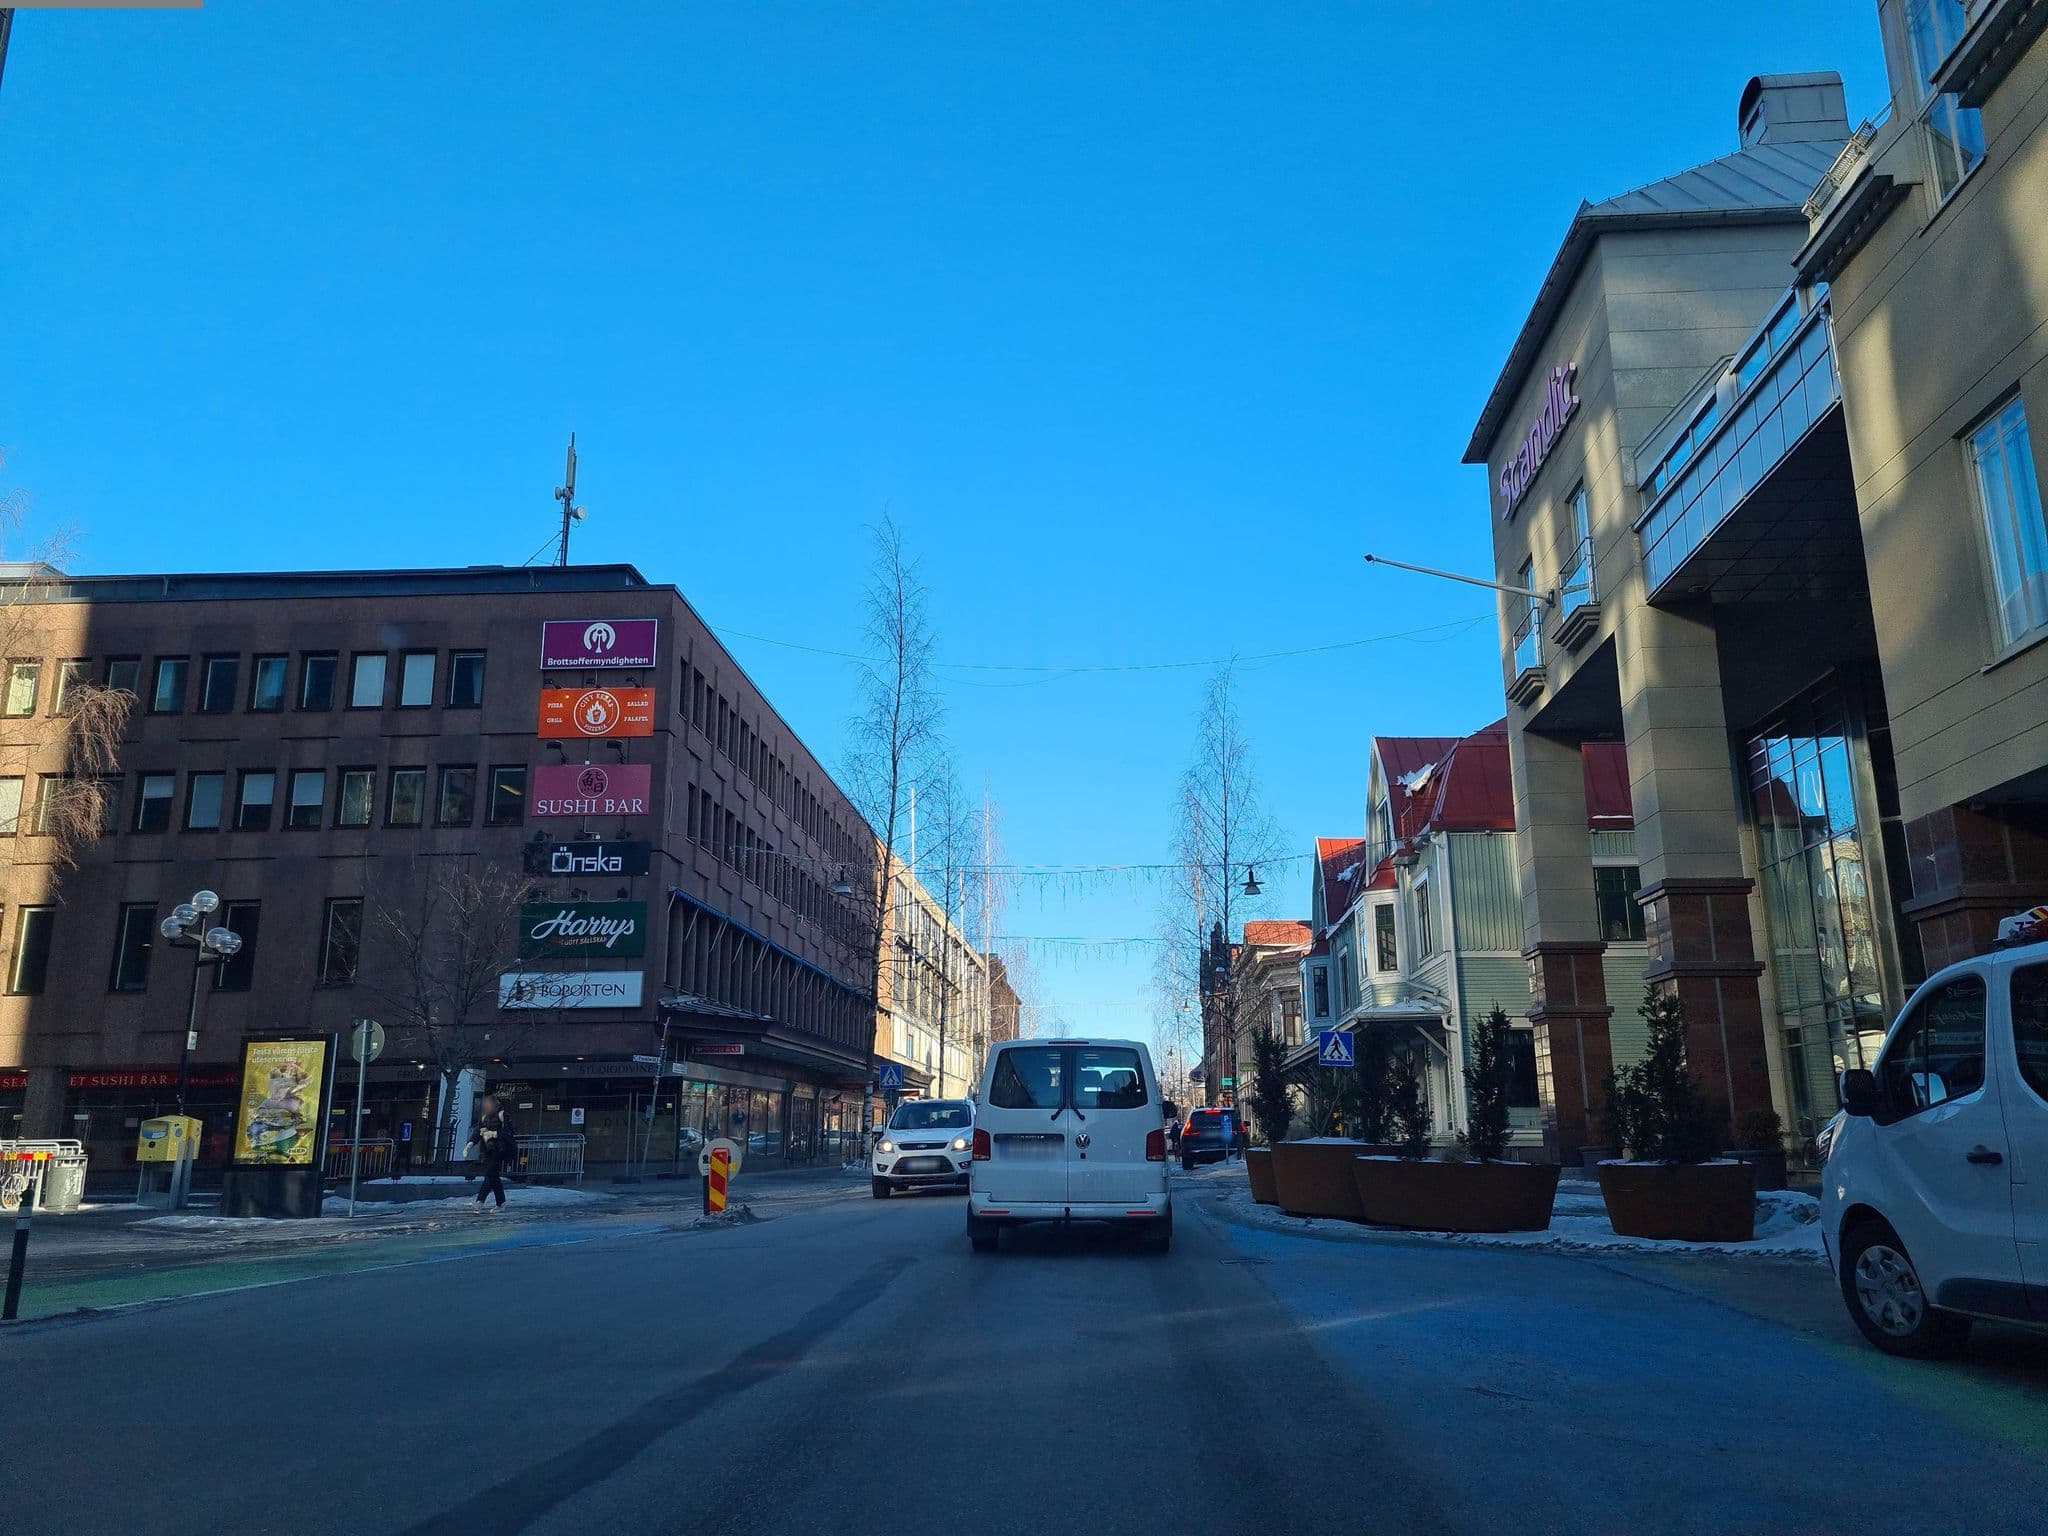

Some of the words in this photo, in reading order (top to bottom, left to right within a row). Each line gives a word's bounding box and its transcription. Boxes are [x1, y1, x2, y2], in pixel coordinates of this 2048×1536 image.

[1500, 362, 1579, 521] Scandic
[547, 656, 649, 667] Brottsoffermyndigheten
[537, 799, 597, 814] SUSHI
[604, 799, 643, 813] BAR
[551, 846, 622, 873] Önska
[530, 910, 635, 949] Harrys
[91, 1075, 134, 1086] SUSHI
[140, 1075, 167, 1085] BAR
